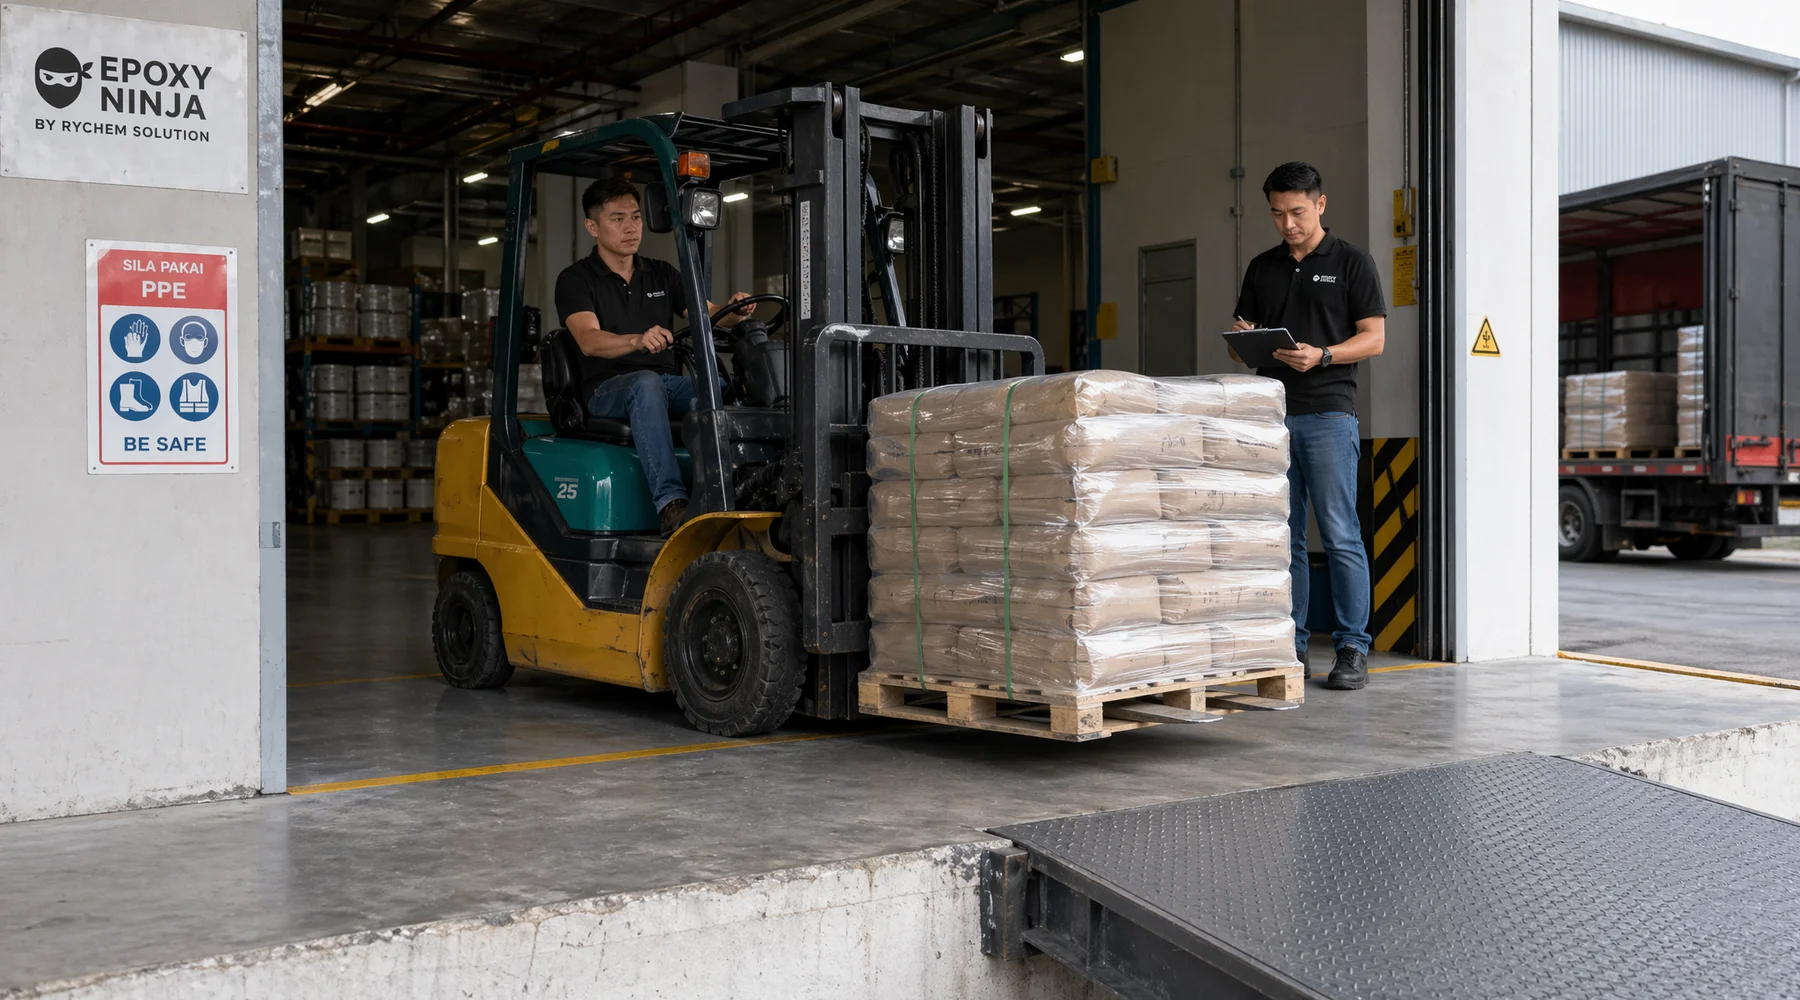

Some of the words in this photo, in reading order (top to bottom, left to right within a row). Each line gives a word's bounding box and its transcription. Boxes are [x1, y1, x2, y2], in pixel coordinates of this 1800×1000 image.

[101, 56, 212, 91] EPOXY
[101, 86, 206, 120] NINJA
[35, 119, 56, 132] BY
[62, 120, 127, 136] RYCHEM
[133, 126, 210, 142] SOLUTION
[123, 259, 156, 273] SILA
[161, 260, 204, 275] PAKAI
[142, 280, 186, 300] PPE
[124, 436, 150, 452] BE
[157, 436, 207, 452] SAFE
[556, 483, 579, 499] 25
